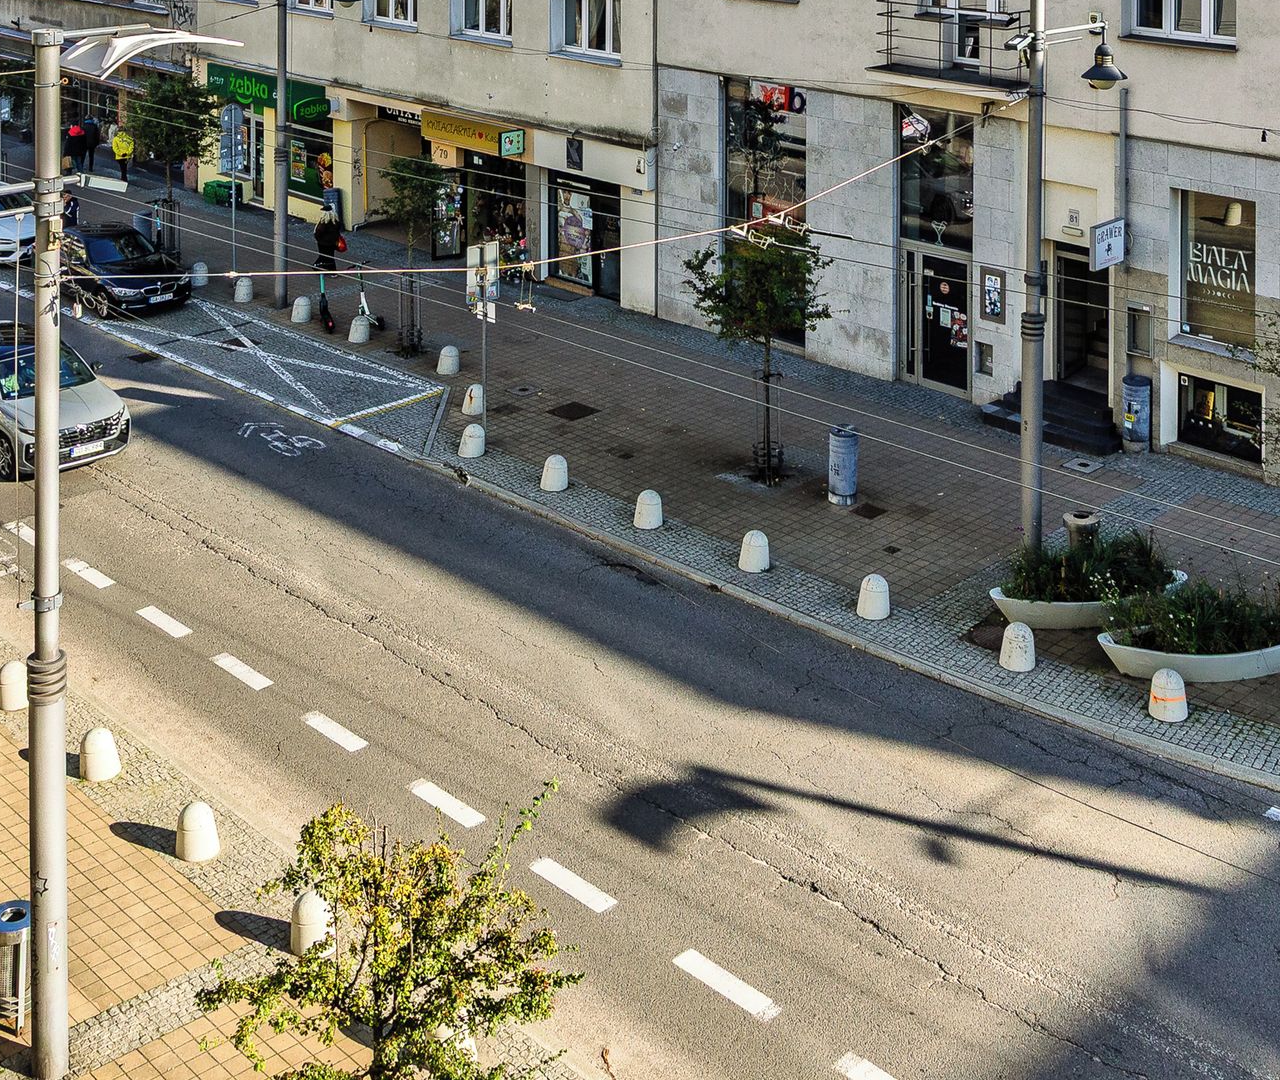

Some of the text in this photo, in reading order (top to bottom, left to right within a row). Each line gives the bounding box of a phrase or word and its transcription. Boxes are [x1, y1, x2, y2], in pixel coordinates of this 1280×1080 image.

[229, 72, 268, 100] żabka
[300, 102, 328, 116] żabka
[439, 148, 449, 159] 79
[1069, 214, 1078, 223] 81
[1189, 241, 1248, 272] BIAŁA
[1187, 262, 1251, 293] MAGIA
